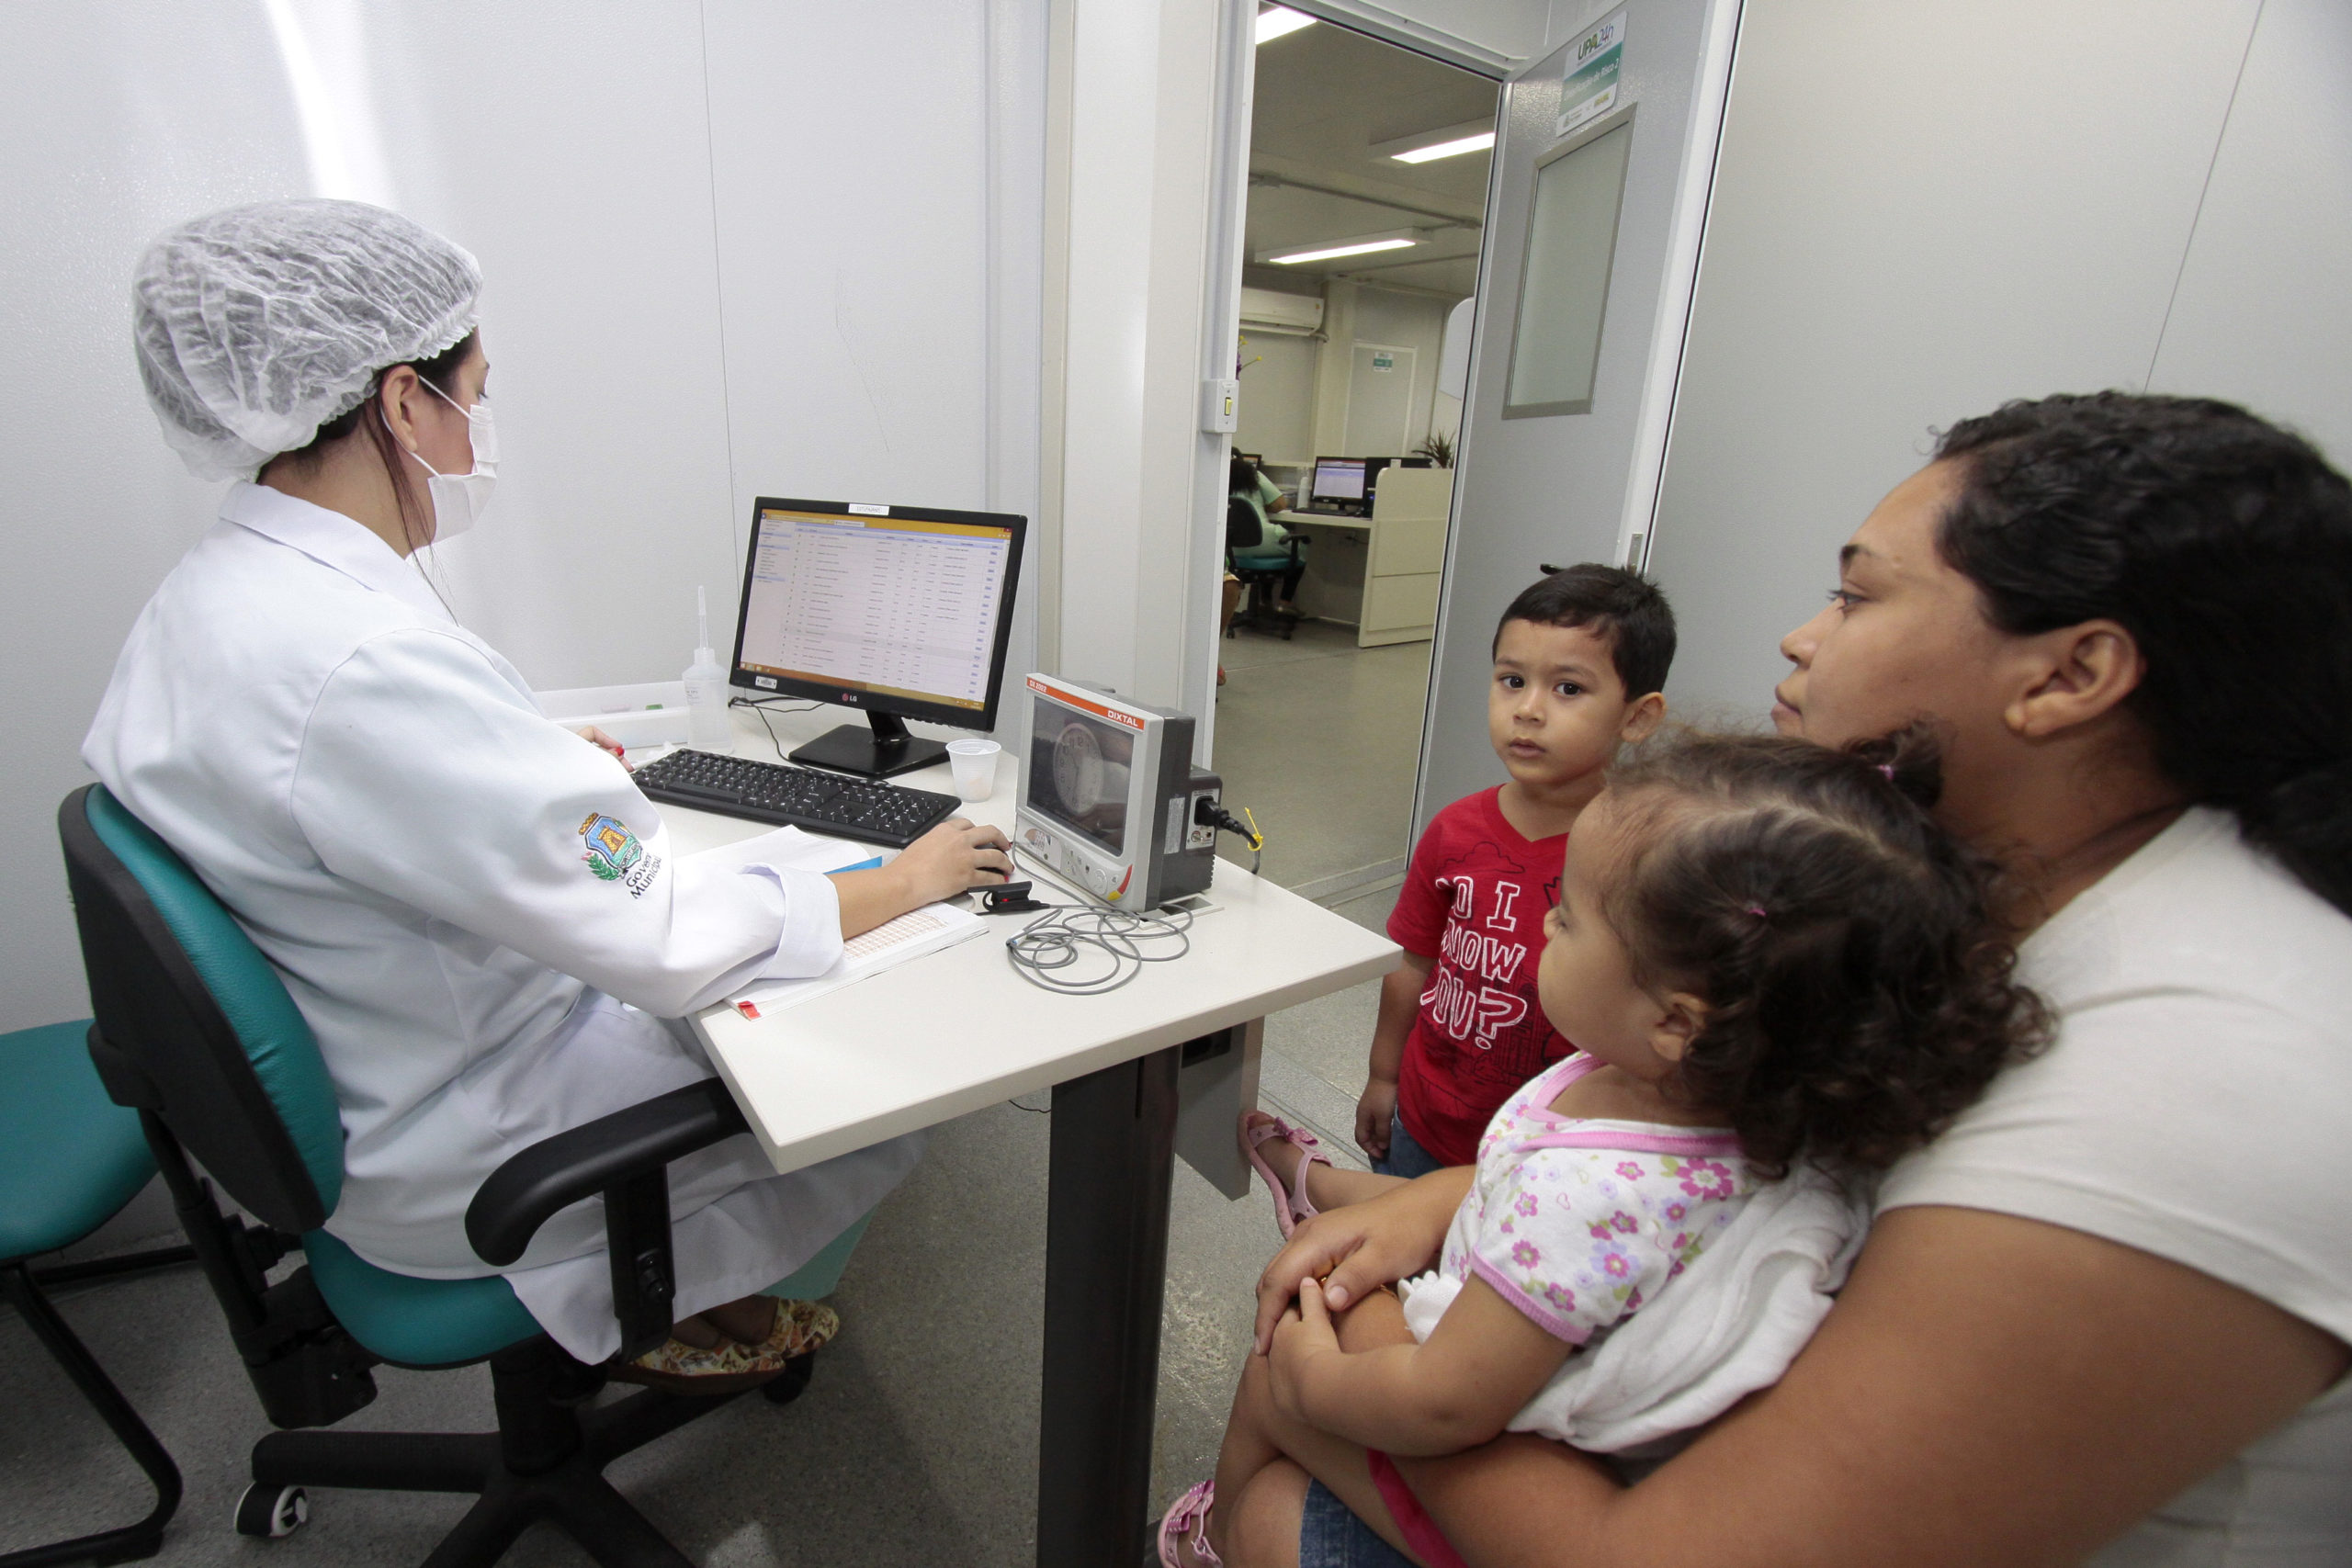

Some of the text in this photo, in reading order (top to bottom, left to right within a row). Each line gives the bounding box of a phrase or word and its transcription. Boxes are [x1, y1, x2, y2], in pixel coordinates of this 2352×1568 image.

[1107, 710, 1138, 727] DIXTAL
[626, 852, 651, 887] Govern
[1487, 880, 1521, 932] I
